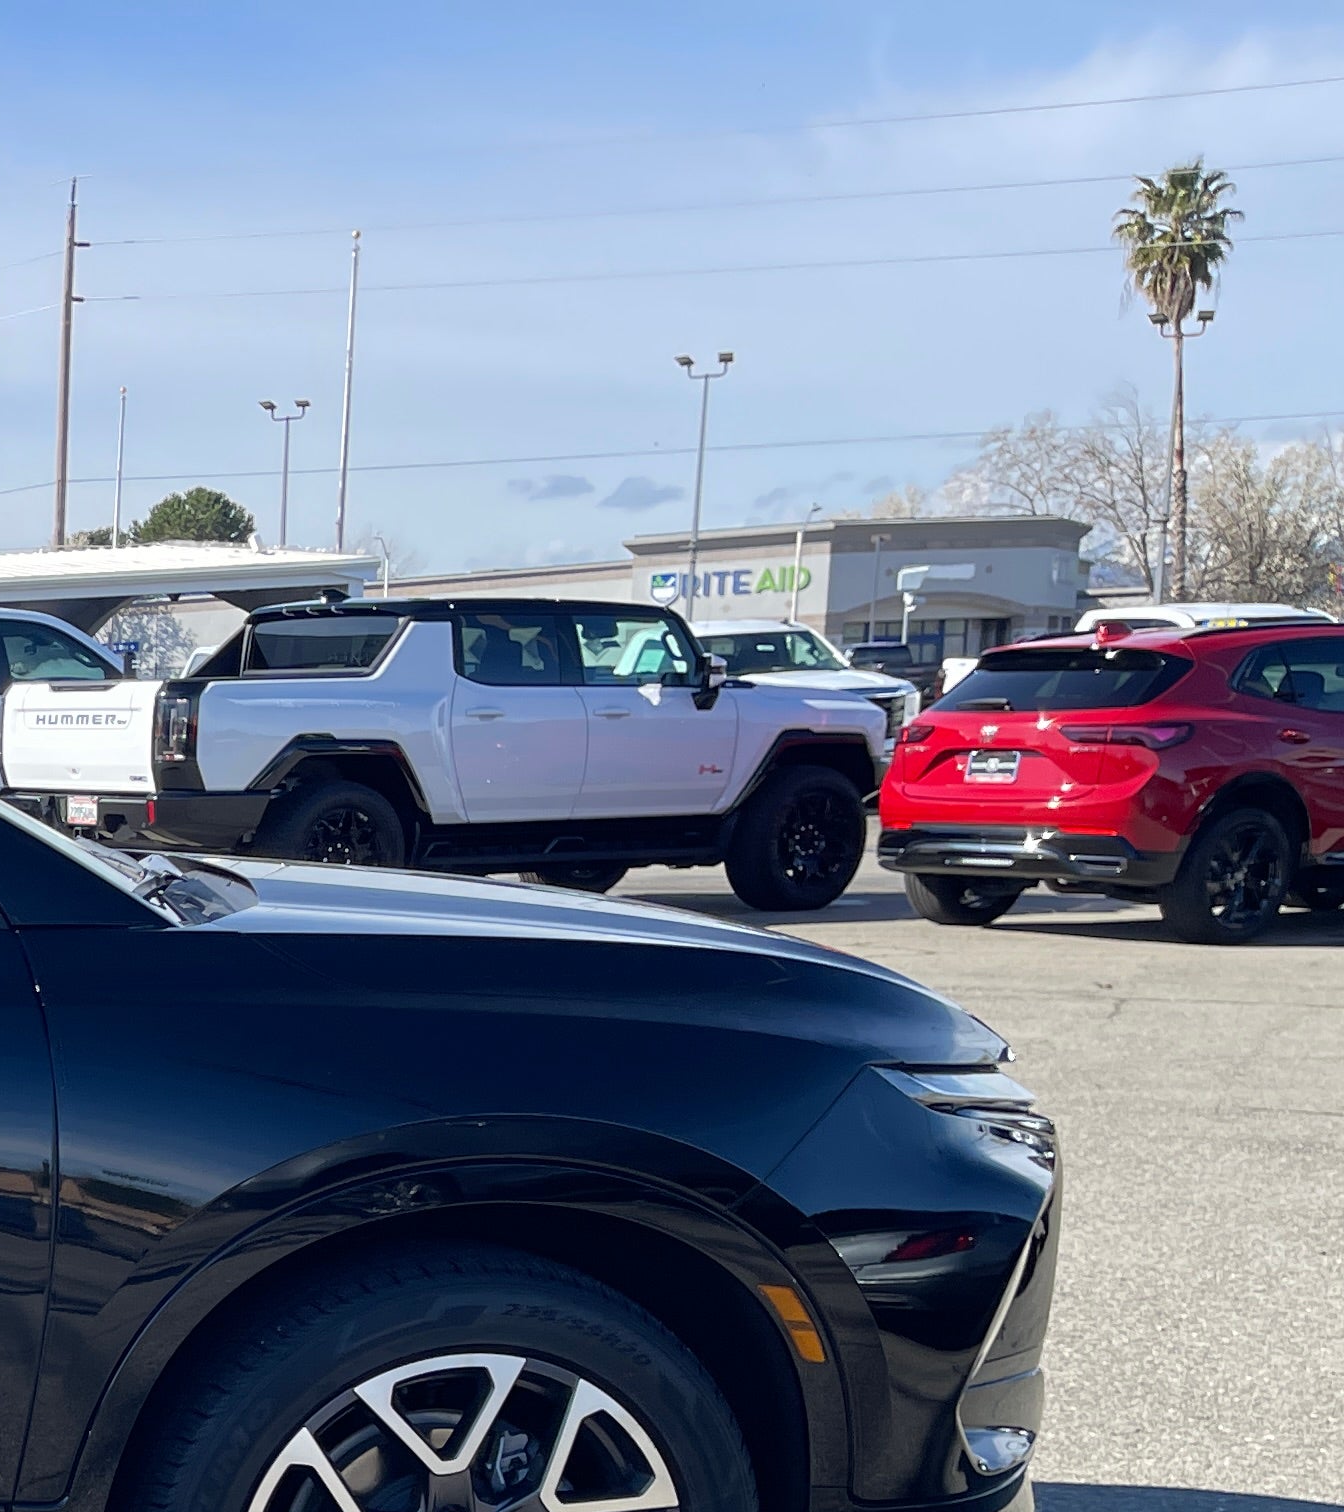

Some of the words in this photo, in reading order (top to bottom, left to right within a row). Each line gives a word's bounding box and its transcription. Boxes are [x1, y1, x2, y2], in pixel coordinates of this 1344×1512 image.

[681, 569, 752, 598] RITE
[756, 565, 811, 593] AID
[35, 714, 117, 725] HUMMER
